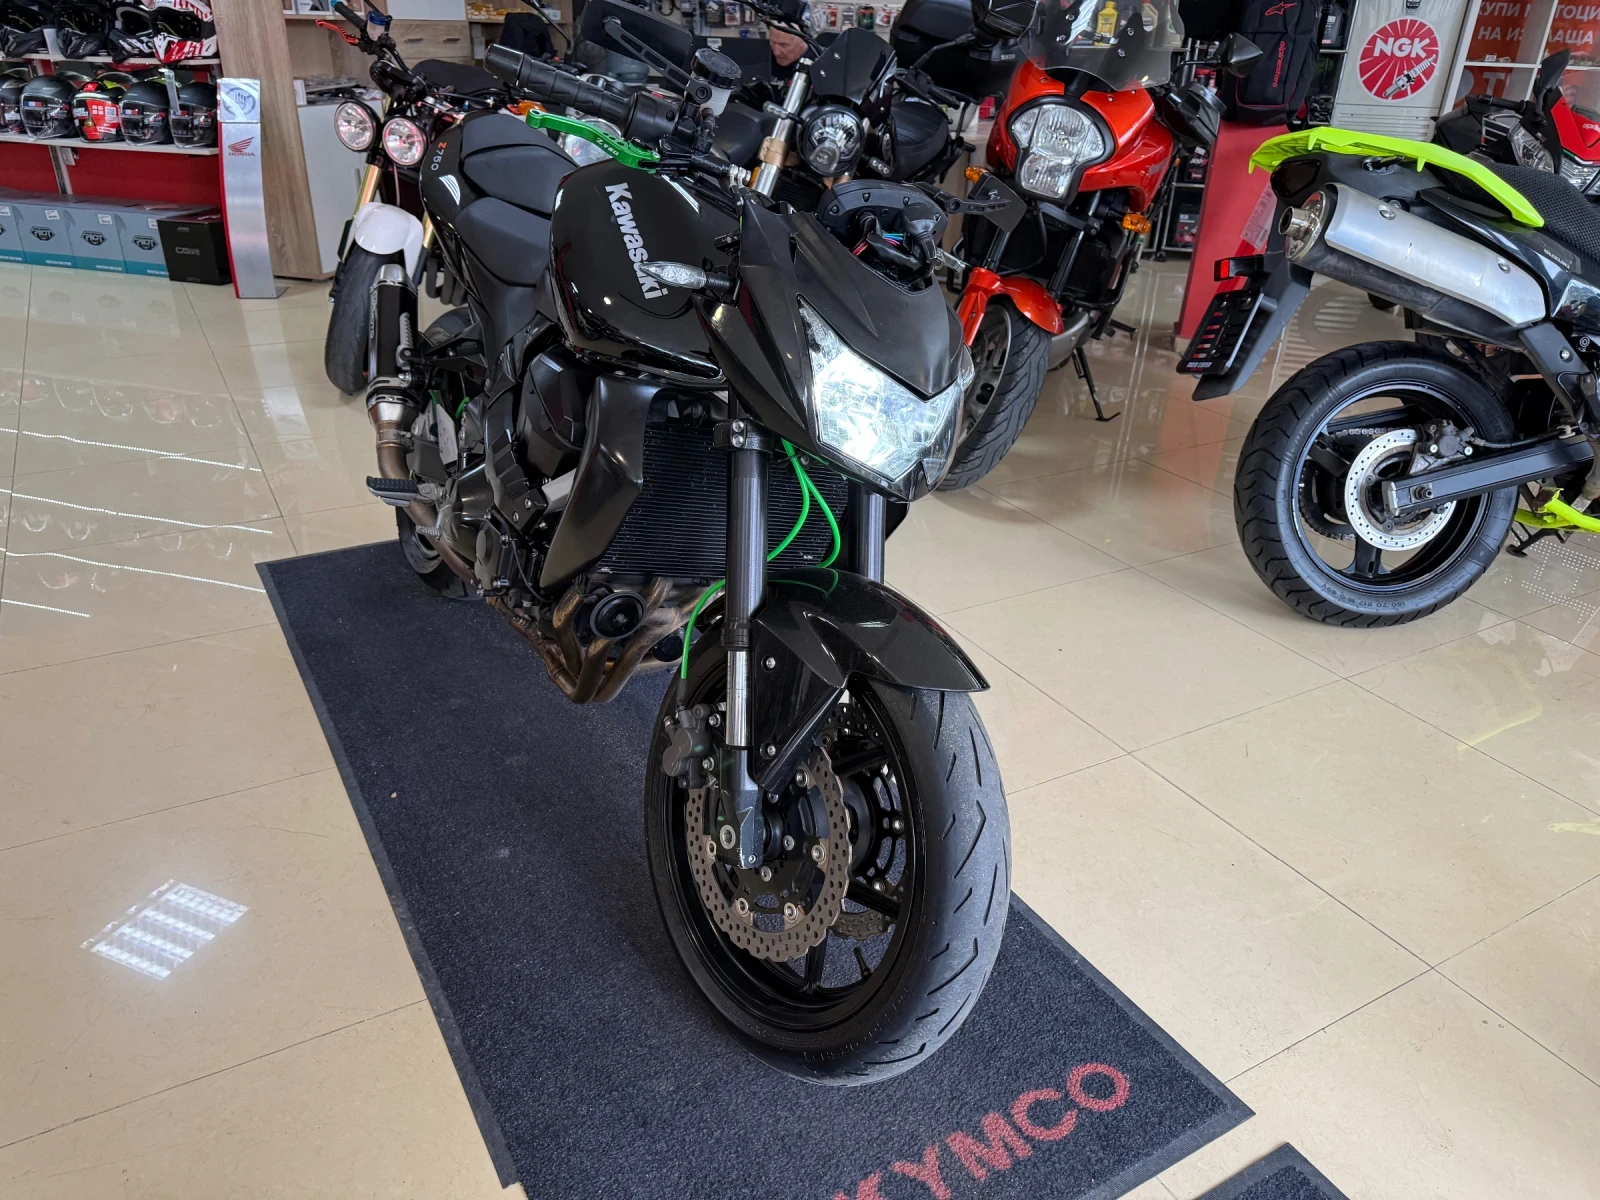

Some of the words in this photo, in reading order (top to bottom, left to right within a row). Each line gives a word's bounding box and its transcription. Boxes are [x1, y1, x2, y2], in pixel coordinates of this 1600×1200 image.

[1477, 26, 1501, 41] НА
[1373, 37, 1430, 58] NGK
[1272, 40, 1286, 88] alpinestars
[431, 142, 447, 171] Z750
[1543, 248, 1570, 269] SUZUKI
